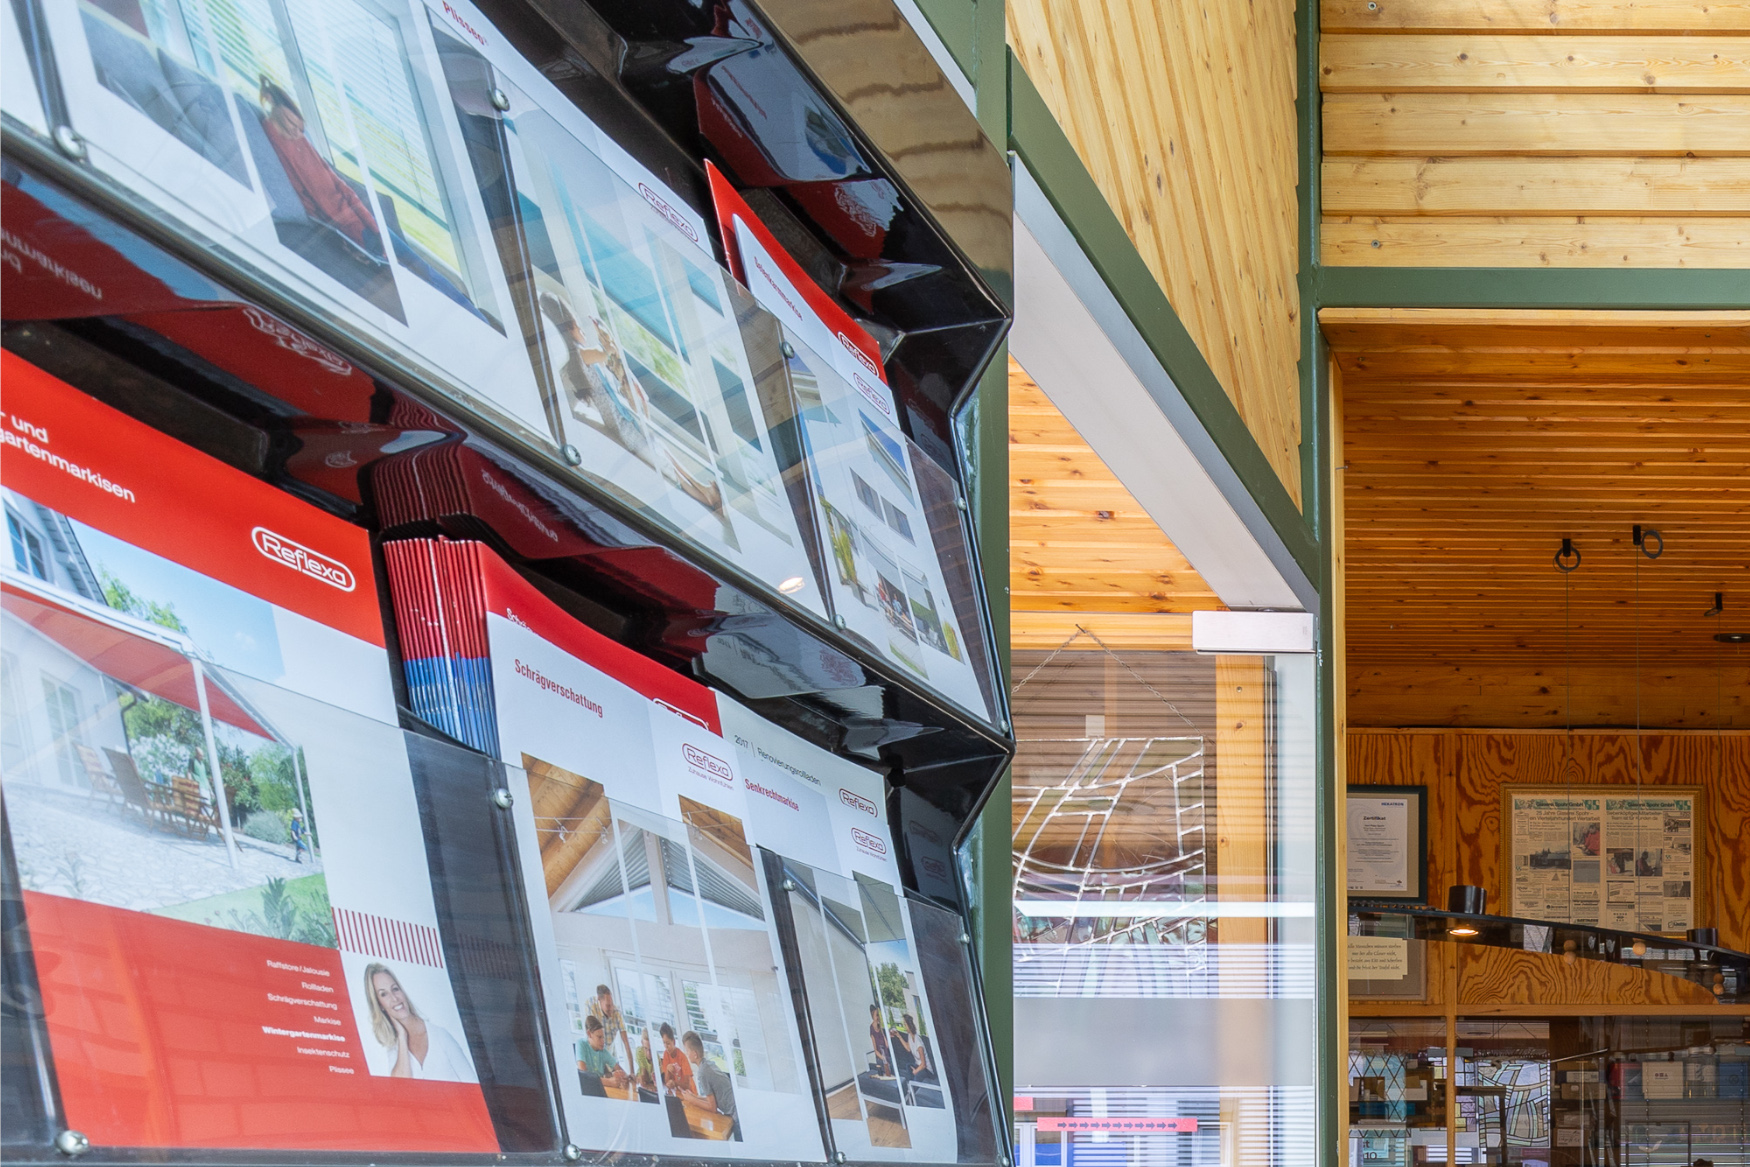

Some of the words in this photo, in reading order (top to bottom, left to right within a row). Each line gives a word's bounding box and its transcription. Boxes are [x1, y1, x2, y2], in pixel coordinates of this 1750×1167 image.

[644, 187, 694, 238] Reflexa
[11, 415, 49, 443] und
[262, 532, 347, 586] Reflexa
[514, 657, 604, 718] Schrägverschattung
[734, 734, 749, 750] 2017
[686, 747, 730, 777] Reflexa
[744, 778, 800, 812] Senkrechtmarkise
[843, 791, 874, 814] Reflexa
[854, 831, 885, 851] Reflexa
[313, 1016, 342, 1026] Markise
[262, 1026, 346, 1042] Wintergartenmarkise
[297, 1046, 350, 1058] Insektenschutz
[329, 1065, 354, 1075] Plissee
